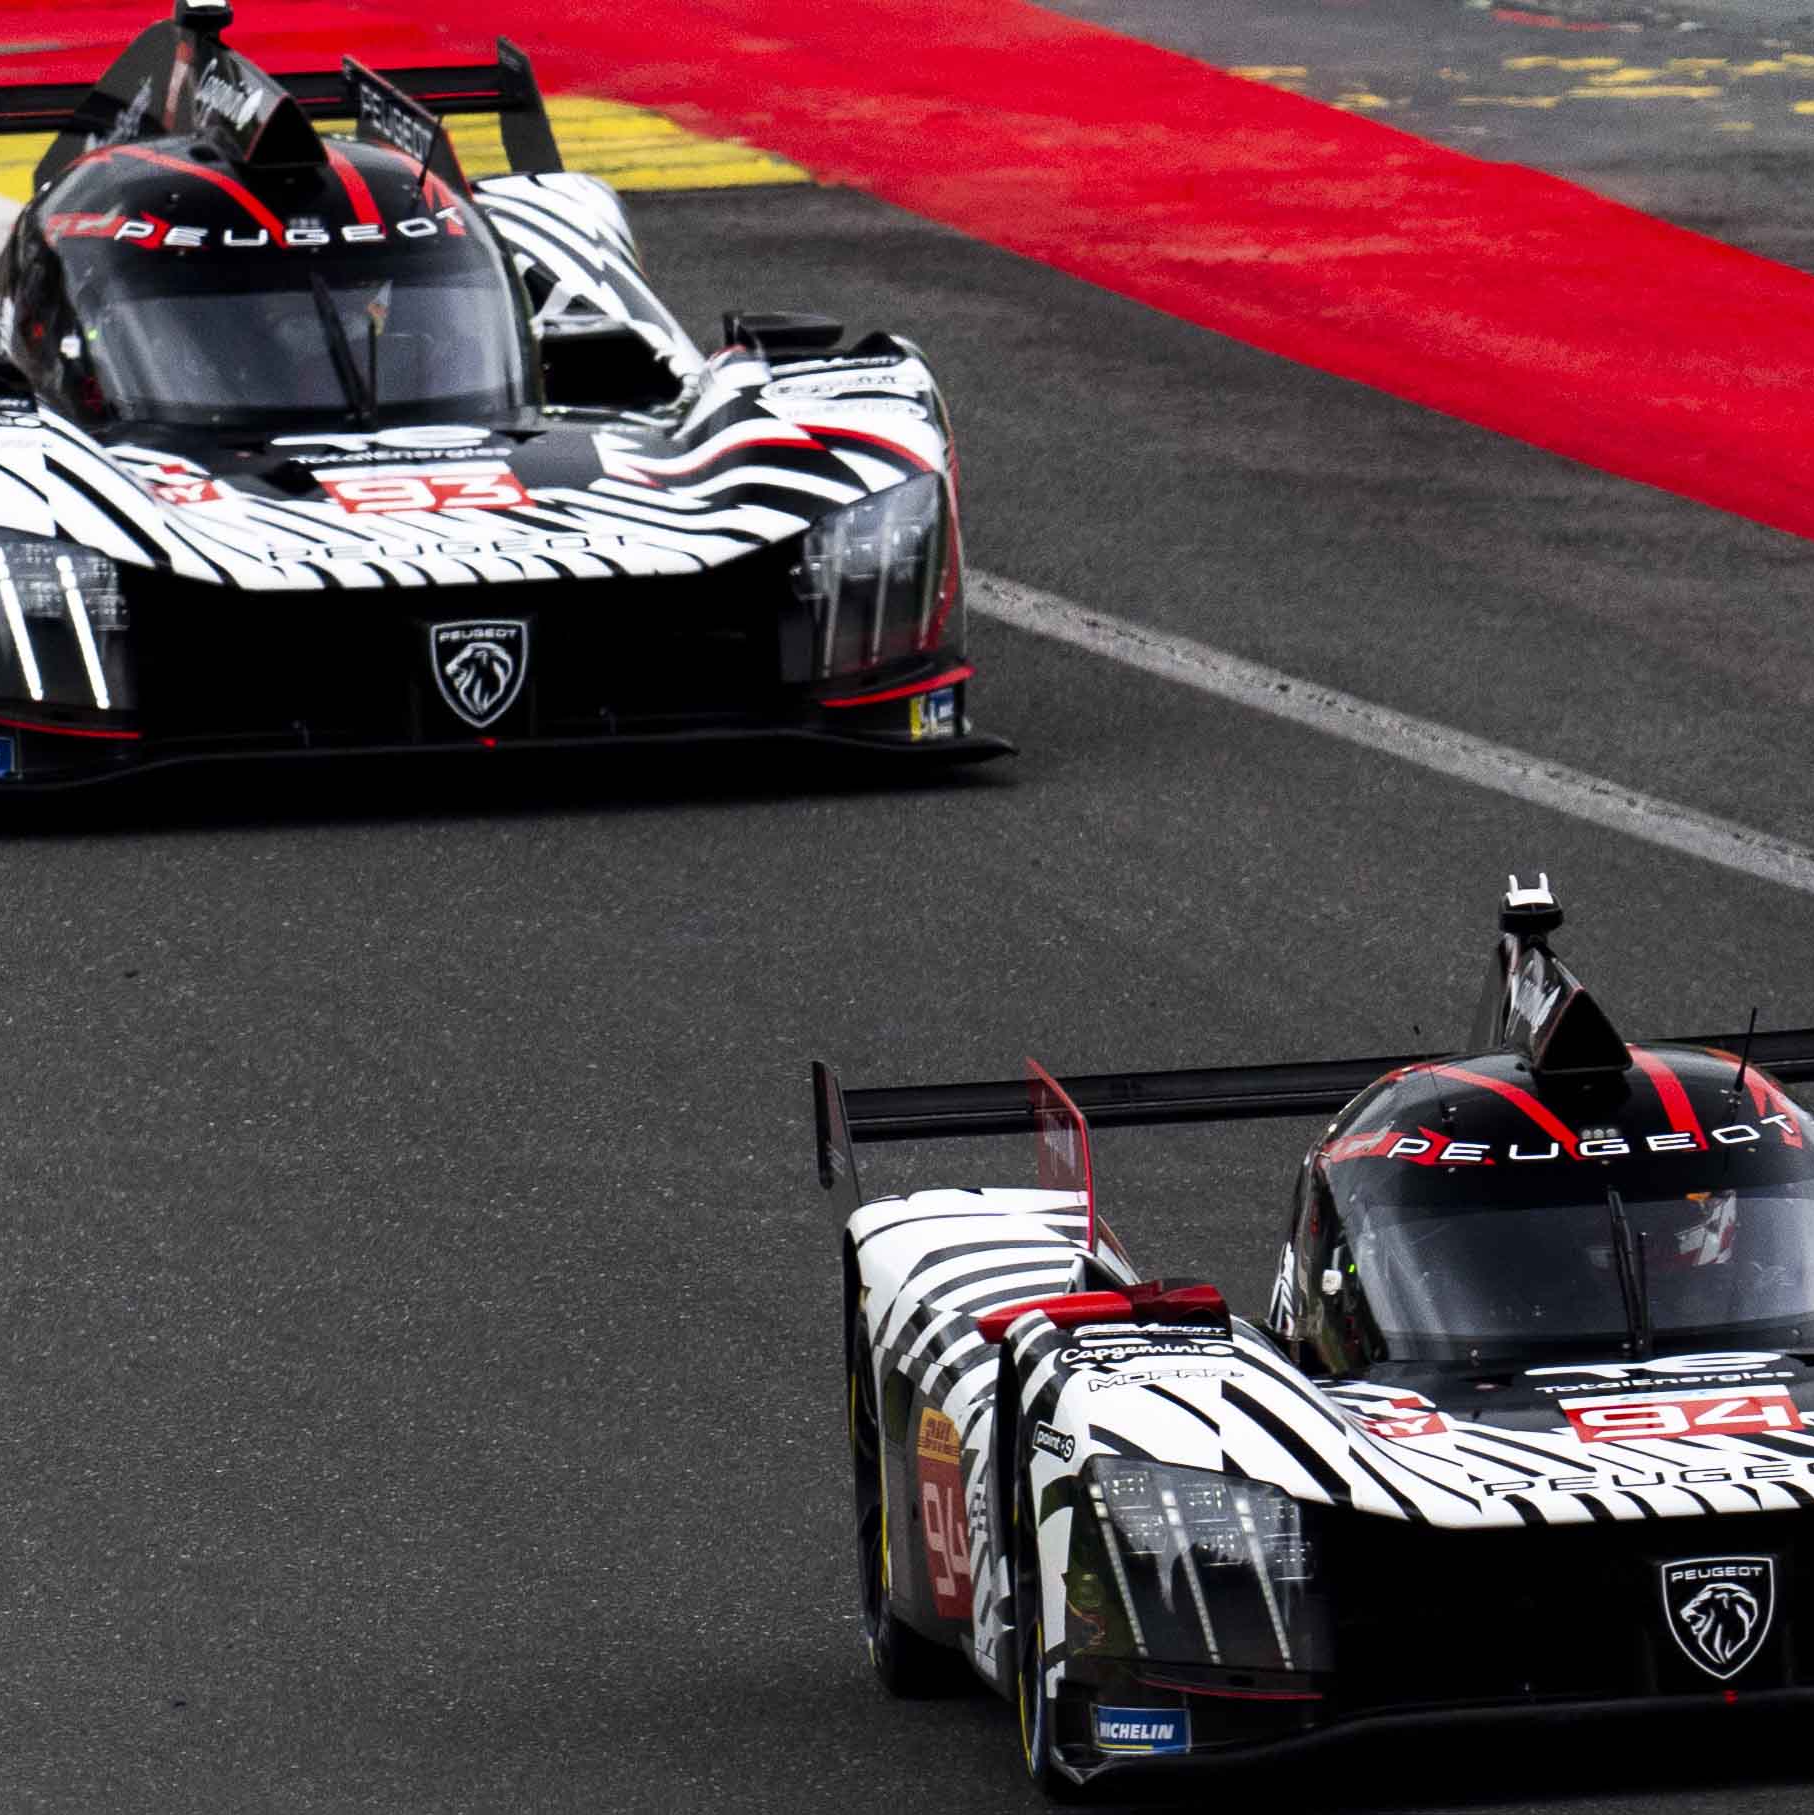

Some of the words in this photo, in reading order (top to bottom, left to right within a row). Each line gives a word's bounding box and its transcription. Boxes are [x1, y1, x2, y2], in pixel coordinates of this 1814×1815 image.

[115, 207, 461, 247] PEUGEOT
[335, 474, 523, 512] 93
[267, 534, 639, 561] PEUGEOT
[439, 628, 516, 642] PEUGEOT
[1387, 1115, 1795, 1162] PEUGEOT
[1061, 1344, 1201, 1363] Capgemini
[1535, 1372, 1795, 1394] TotalEnergies
[1580, 1400, 1792, 1437] 94
[922, 1482, 971, 1597] 94
[1672, 1566, 1763, 1582] PEUGEOT
